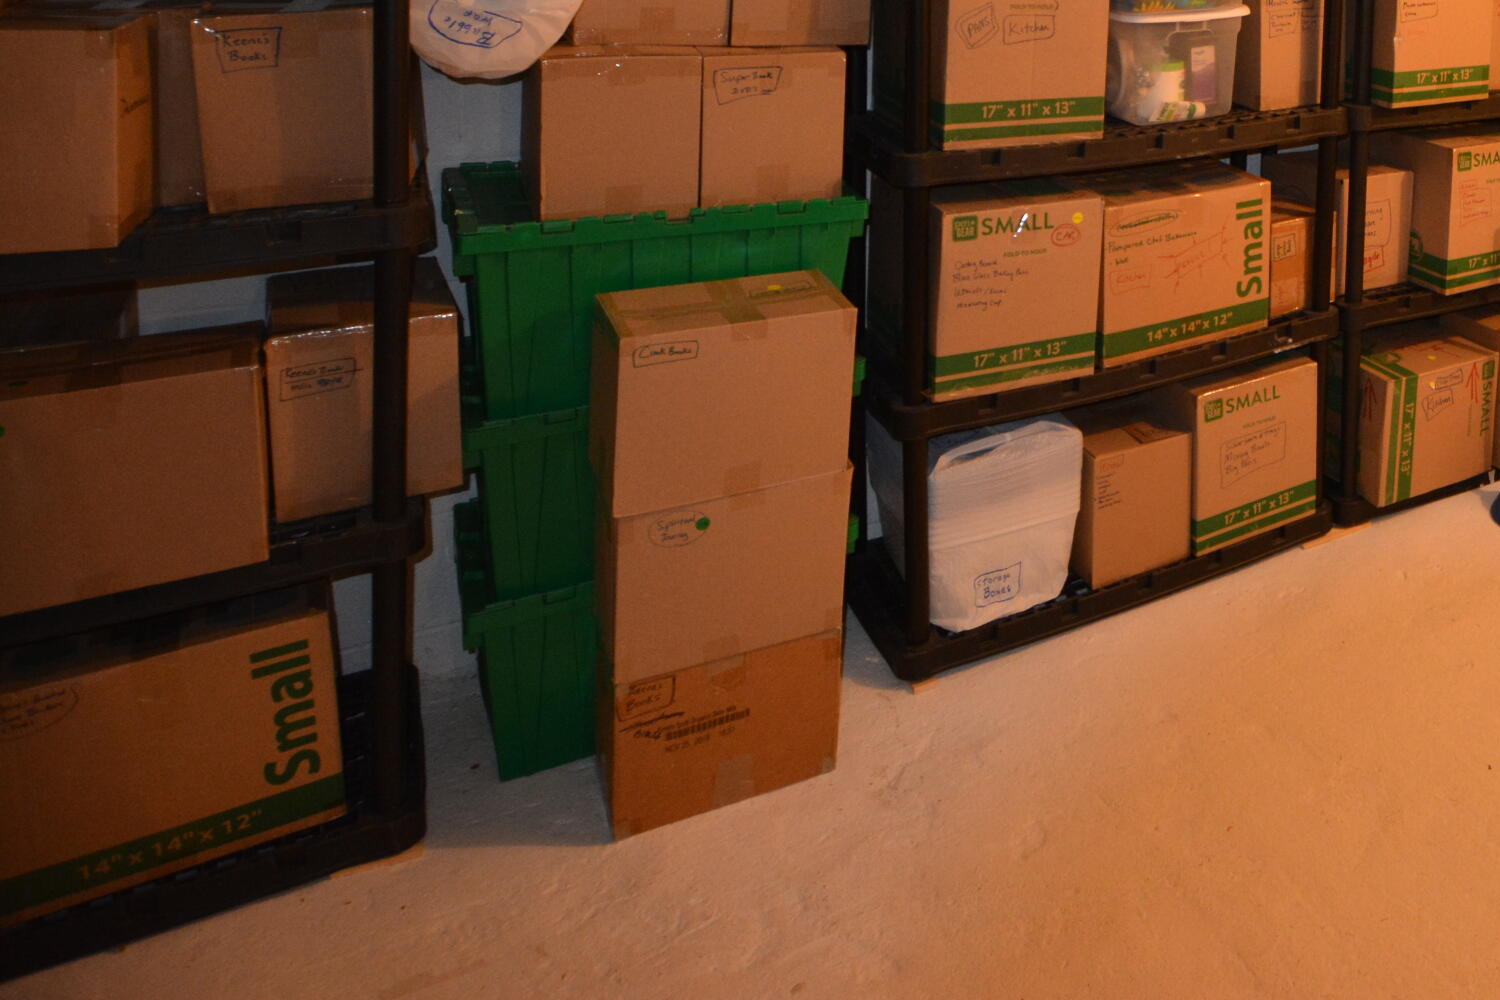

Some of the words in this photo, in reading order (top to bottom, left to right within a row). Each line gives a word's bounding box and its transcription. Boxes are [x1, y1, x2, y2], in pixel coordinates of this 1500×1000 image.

[1417, 72, 1431, 85] 17"
[1440, 70, 1452, 82] 11"
[1461, 68, 1475, 81] 13"
[982, 103, 1004, 119] 17"
[1007, 107, 1017, 118] x
[1020, 102, 1039, 117] 11"
[1042, 105, 1052, 116] x
[1054, 100, 1077, 115] 13"
[982, 211, 1055, 236] SMALL
[1236, 198, 1264, 298] Small
[1146, 327, 1169, 343] 14"
[1170, 327, 1178, 338] x
[1180, 319, 1201, 336] 14"
[1202, 318, 1210, 330] x
[1213, 311, 1233, 326] 12"
[972, 353, 996, 368] 17"
[999, 353, 1007, 365] x
[1012, 346, 1031, 361] 11"
[1034, 347, 1043, 358] x
[1046, 340, 1067, 356] 13"
[1225, 385, 1281, 414] SMALL
[1480, 380, 1494, 437] SMALL
[1224, 510, 1240, 525] 17"
[1252, 503, 1266, 518] 11"
[1279, 491, 1295, 507] 13"
[249, 638, 323, 786] Small
[80, 854, 122, 881] 14"
[128, 850, 145, 866] x
[152, 830, 194, 858] 14"
[199, 828, 216, 843] x
[221, 808, 264, 836] 12"
